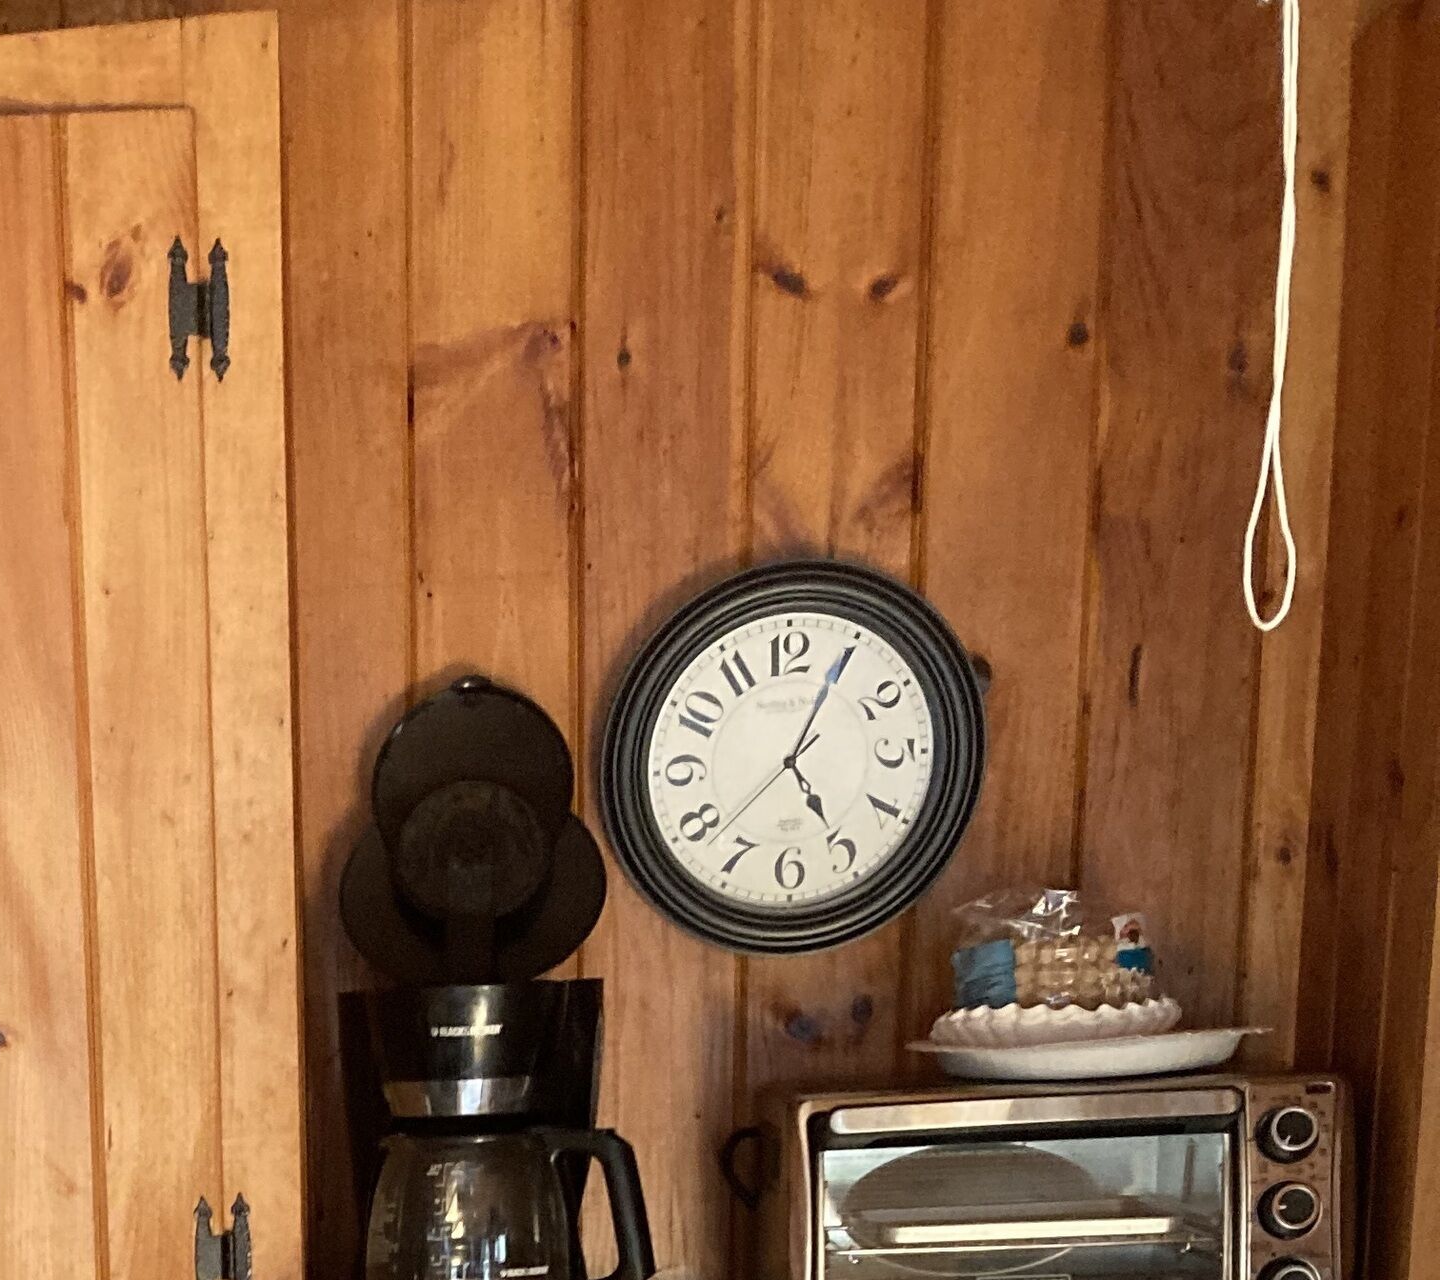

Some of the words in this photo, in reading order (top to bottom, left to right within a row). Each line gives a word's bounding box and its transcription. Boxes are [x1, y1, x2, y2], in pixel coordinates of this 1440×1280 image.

[718, 650, 757, 697] 11
[768, 630, 810, 677] 12
[678, 690, 724, 738] 10
[857, 680, 902, 721] 2
[665, 754, 708, 787] 9
[874, 737, 916, 769] 3
[679, 803, 720, 842] 8
[864, 792, 901, 830] 4
[720, 834, 760, 874] 7
[774, 847, 806, 889] 6
[825, 825, 857, 873] 5
